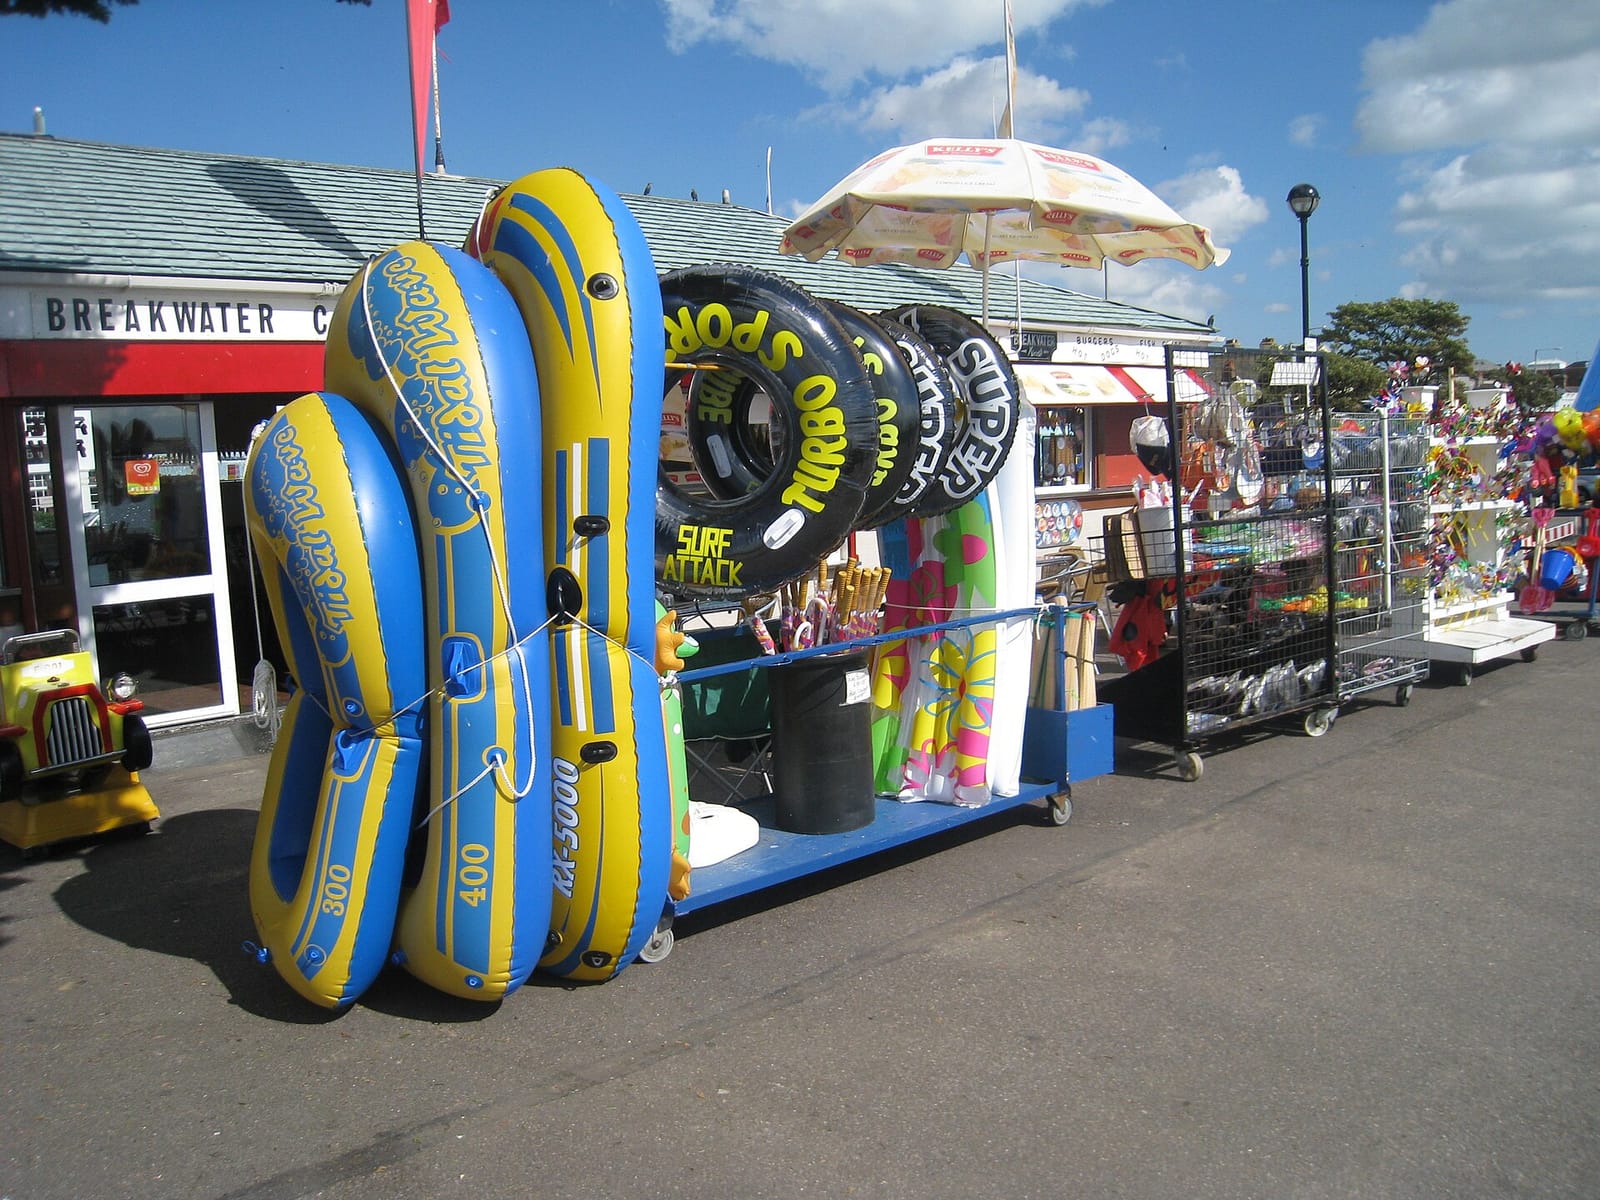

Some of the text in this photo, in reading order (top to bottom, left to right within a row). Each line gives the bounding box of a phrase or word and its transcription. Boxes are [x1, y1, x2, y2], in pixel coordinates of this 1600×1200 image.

[47, 298, 274, 334] BREAKWATER
[1013, 333, 1056, 347] BEAKWATER
[1076, 336, 1114, 346] BURGERS
[939, 338, 1013, 499] SUPER
[782, 374, 847, 513] TURBO
[677, 525, 734, 557] SURF
[663, 554, 743, 586] ATTACK
[552, 756, 580, 898] RX-5000
[322, 864, 351, 916] 300
[459, 843, 490, 907] 400
